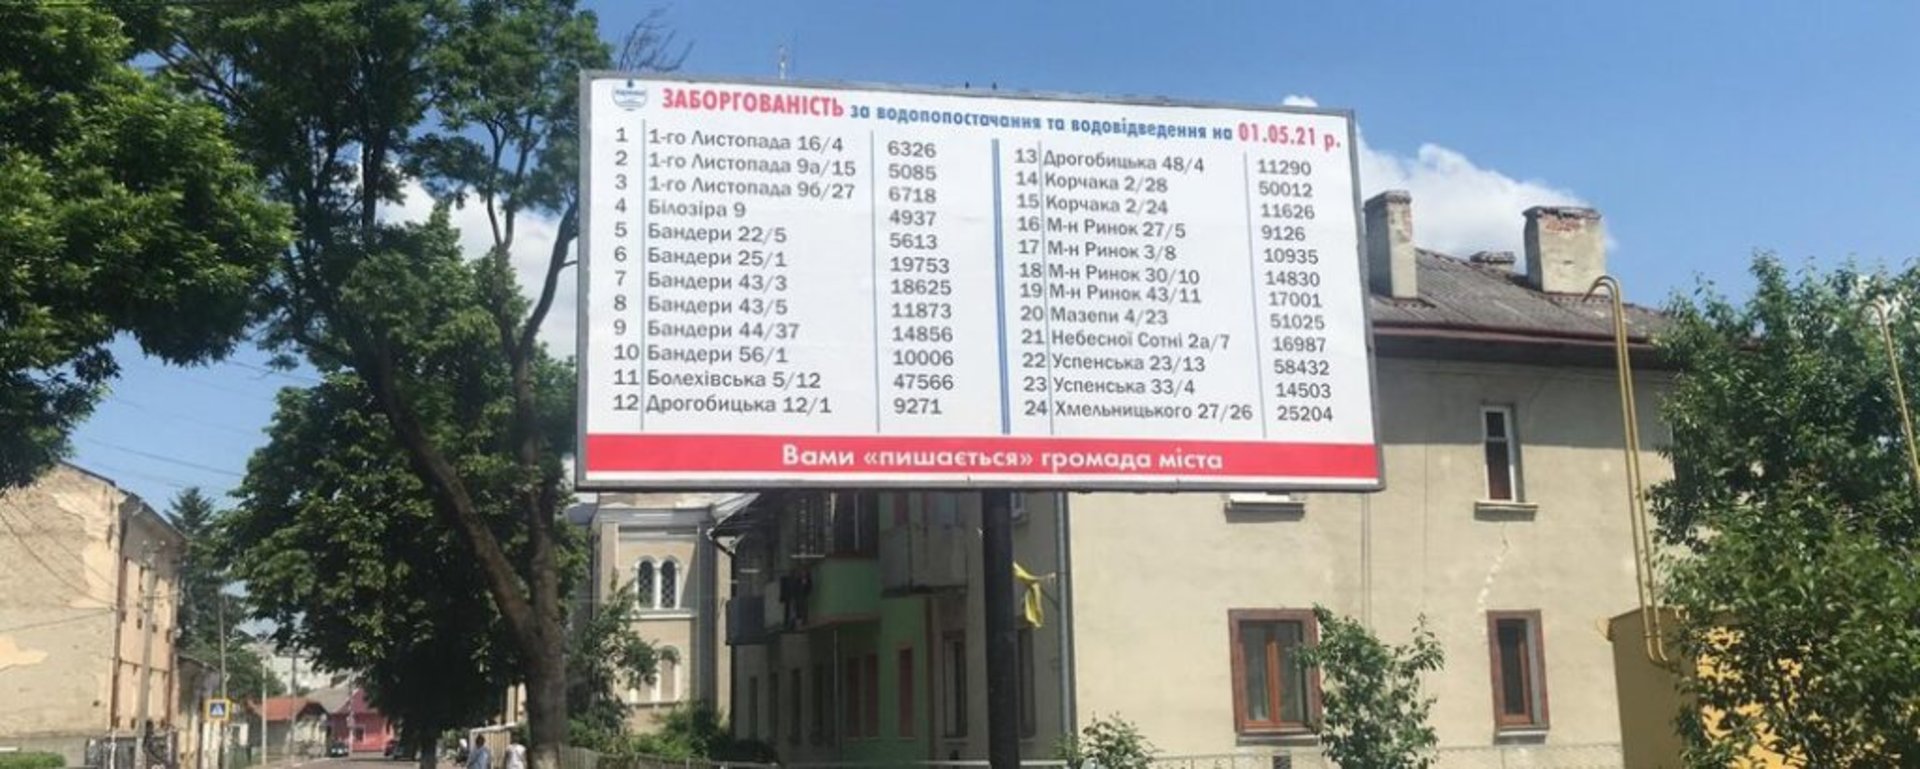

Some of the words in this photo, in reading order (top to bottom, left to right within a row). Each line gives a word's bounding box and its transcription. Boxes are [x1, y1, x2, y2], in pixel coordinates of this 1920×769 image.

[662, 88, 845, 118] ЗАБОРГОВАНІСТЬ
[850, 105, 870, 119] за
[1047, 118, 1064, 130] та
[1071, 117, 1206, 140] водовідведення
[1212, 129, 1232, 140] на
[1238, 123, 1315, 145] 01.05.21
[1324, 132, 1341, 150] р.
[615, 127, 628, 143] 1
[648, 129, 686, 146] 1-го
[690, 129, 791, 150] Листопада
[797, 135, 843, 153] 16/4
[887, 141, 937, 159] 6326
[615, 151, 628, 167] 2
[648, 153, 686, 171] 1-го
[690, 153, 791, 175] Листопада
[887, 164, 937, 182] 5085
[1015, 149, 1037, 165] 13
[1043, 149, 1157, 173] Дрогобицька
[1162, 156, 1204, 174] 48/4
[1258, 159, 1311, 176] 11290
[615, 175, 628, 190] 3
[648, 177, 686, 194] 1-го
[690, 178, 792, 198] Листопада
[887, 186, 937, 204] 6718
[1016, 171, 1038, 186] 14
[1045, 173, 1119, 193] Корчака
[1125, 177, 1168, 193] 2/28
[1259, 181, 1312, 197] 50012
[615, 199, 627, 214] 4
[648, 200, 727, 220] Білозіра
[733, 202, 746, 219] 9
[888, 210, 937, 227] 4937
[1017, 193, 1039, 209] 15
[1046, 195, 1120, 215] Корчака
[1125, 198, 1168, 215] 2/24
[1260, 204, 1314, 220] 11626
[615, 223, 627, 238] 5
[648, 224, 732, 245] Бандери
[737, 227, 787, 244] 22/5
[889, 233, 937, 249] 5613
[1017, 216, 1040, 232] 16
[1047, 218, 1080, 234] М-н
[1084, 220, 1138, 236] Ринок
[1143, 222, 1186, 239] 27/5
[1261, 225, 1305, 241] 9126
[614, 247, 627, 262] 6
[648, 248, 732, 269] Бандери
[737, 251, 787, 268] 25/1
[890, 257, 950, 274] 19753
[1018, 239, 1039, 255] 17
[1047, 241, 1080, 257] М-н
[1085, 243, 1139, 259] Ринок
[1143, 245, 1176, 261] 3/8
[1264, 248, 1318, 265] 10935
[614, 271, 626, 286] 7
[648, 273, 732, 294] Бандери
[738, 273, 788, 291] 43/3
[891, 279, 952, 296] 18625
[1020, 263, 1041, 279] 18
[1049, 264, 1081, 281] М-н
[1086, 265, 1140, 282] Ринок
[1145, 267, 1200, 285] 30/10
[1265, 270, 1320, 287] 14830
[614, 295, 627, 311] 8
[648, 298, 732, 318] Бандери
[738, 298, 788, 316] 43/5
[892, 302, 952, 319] 11873
[1020, 283, 1041, 299] 19
[1049, 284, 1081, 300] М-н
[1086, 285, 1141, 302] Ринок
[1146, 286, 1201, 304] 43/11
[1269, 290, 1323, 308] 17001
[1020, 306, 1043, 322] 20
[1050, 307, 1119, 324] Мазепи
[1124, 308, 1168, 325] 4/23
[1270, 314, 1325, 330] 51025
[614, 320, 626, 336] 9
[648, 321, 732, 342] Бандери
[738, 322, 800, 340] 44/37
[892, 326, 954, 343] 14856
[1022, 330, 1043, 345] 21
[1051, 330, 1134, 347] Небесної
[1138, 331, 1183, 348] Сотні
[1273, 335, 1327, 352] 16987
[614, 344, 640, 361] 10
[647, 345, 732, 367] Бандери
[739, 347, 789, 364] 56/1
[893, 350, 954, 367] 10006
[1022, 353, 1046, 368] 22
[1053, 354, 1145, 374] Успенська
[1150, 355, 1205, 372] 23/13
[1274, 358, 1329, 375] 58432
[614, 369, 639, 386] 11
[647, 370, 766, 388] Болехівська
[772, 371, 821, 390] 5/12
[893, 373, 954, 390] 47566
[1024, 376, 1047, 392] 23
[1054, 377, 1145, 397] Успенська
[1152, 378, 1194, 396] 33/4
[1276, 381, 1332, 399] 14503
[614, 394, 639, 411] 12
[647, 394, 776, 416] Дрогобицька
[784, 397, 831, 414] 12/1
[894, 398, 942, 415] 9271
[1024, 400, 1047, 416] 24
[1055, 403, 1192, 422] Хмельницького
[1198, 403, 1253, 421] 27/26
[1277, 405, 1333, 422] 25204
[782, 444, 855, 466] Вами
[863, 447, 1033, 467] «пишається»
[1041, 450, 1151, 473] громада
[1159, 447, 1223, 469] міста
